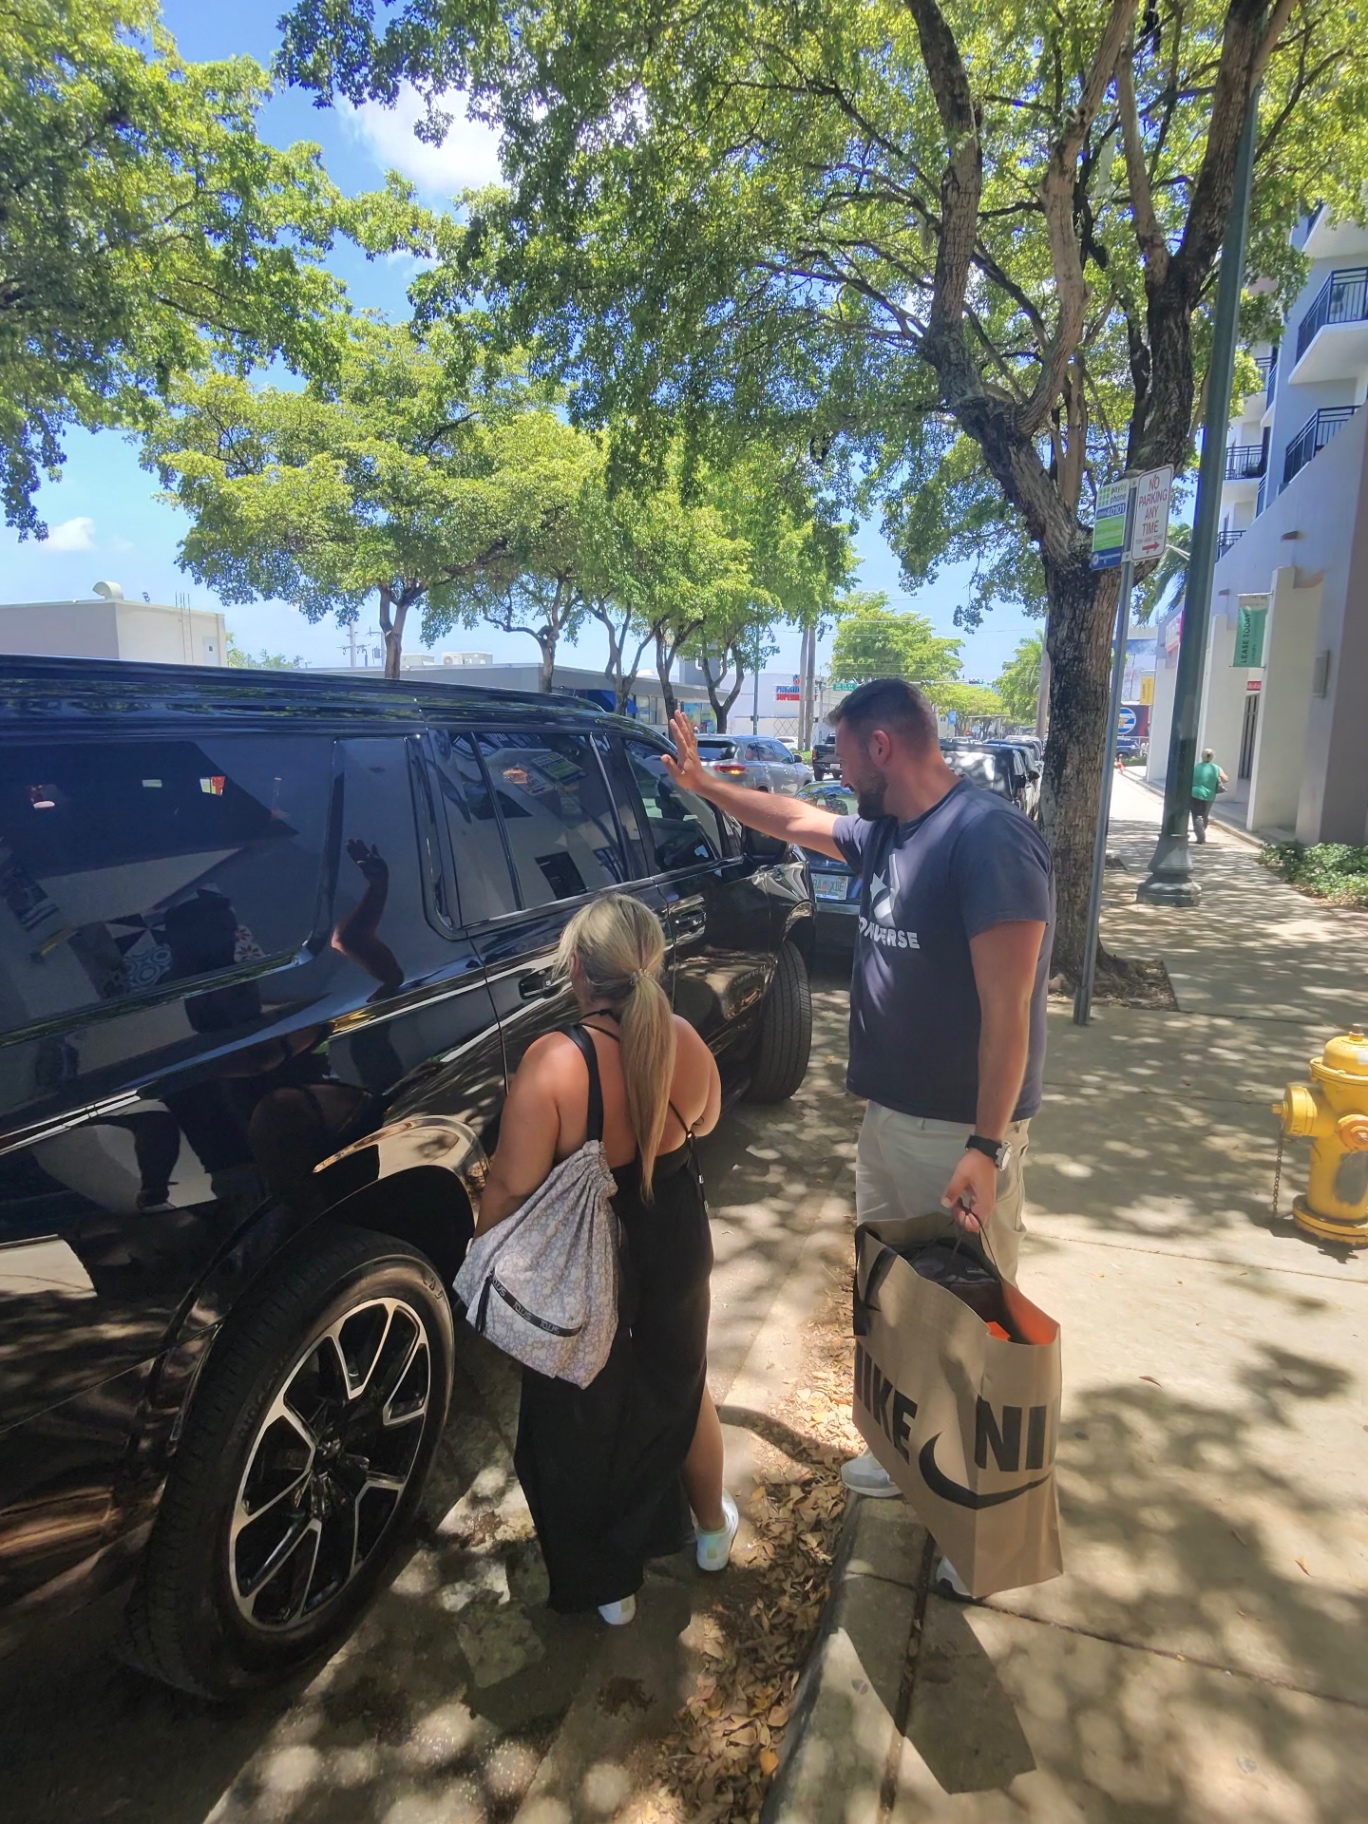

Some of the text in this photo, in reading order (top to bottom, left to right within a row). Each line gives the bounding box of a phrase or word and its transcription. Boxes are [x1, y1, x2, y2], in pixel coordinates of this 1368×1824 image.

[1148, 474, 1160, 491] NO
[1139, 489, 1167, 507] PARKING
[1145, 505, 1159, 520] ANY
[1142, 520, 1159, 536] TIME
[1241, 613, 1251, 663] LEASE TODAY
[859, 915, 920, 949] ONVERSE
[974, 1395, 1058, 1472] NI
